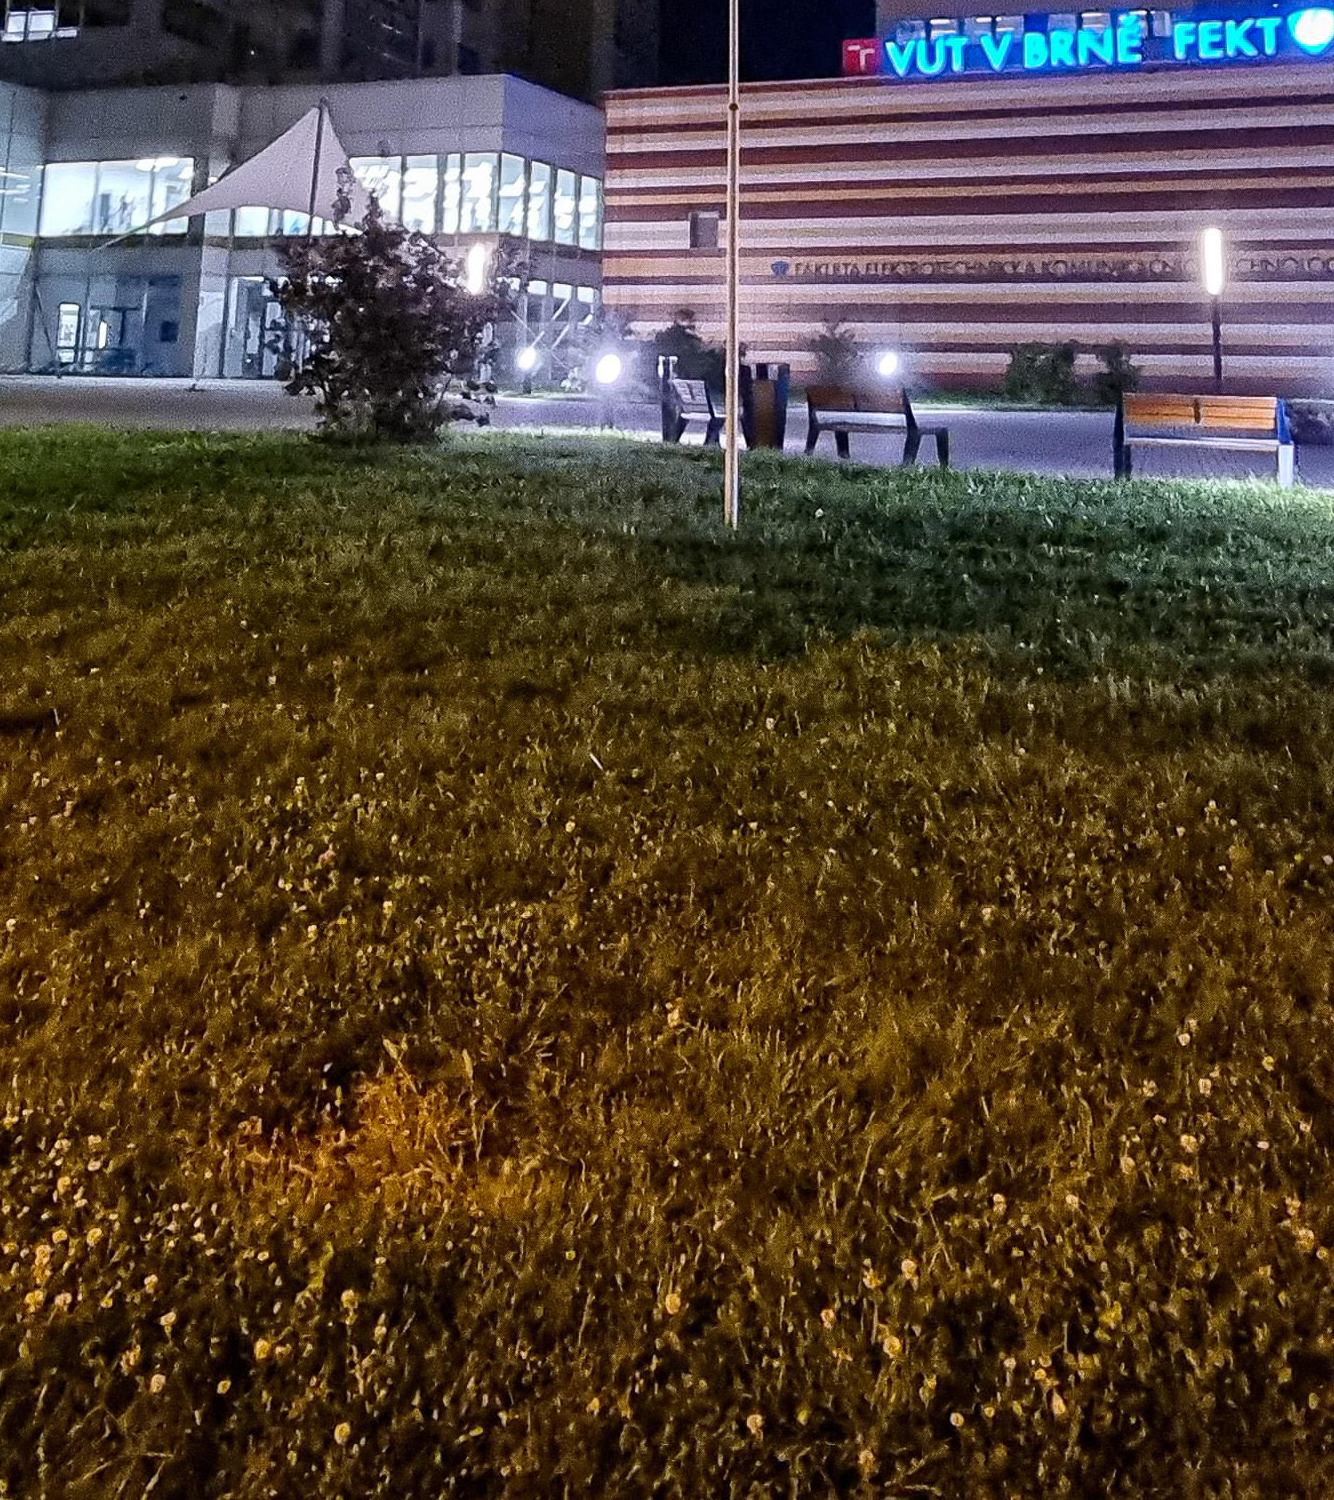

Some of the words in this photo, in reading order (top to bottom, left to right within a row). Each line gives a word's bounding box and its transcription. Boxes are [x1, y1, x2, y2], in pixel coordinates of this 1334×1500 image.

[884, 36, 969, 77] VUT
[979, 34, 1013, 71] V
[1024, 13, 1143, 68] BRNĚ
[1173, 16, 1283, 59] FEKT
